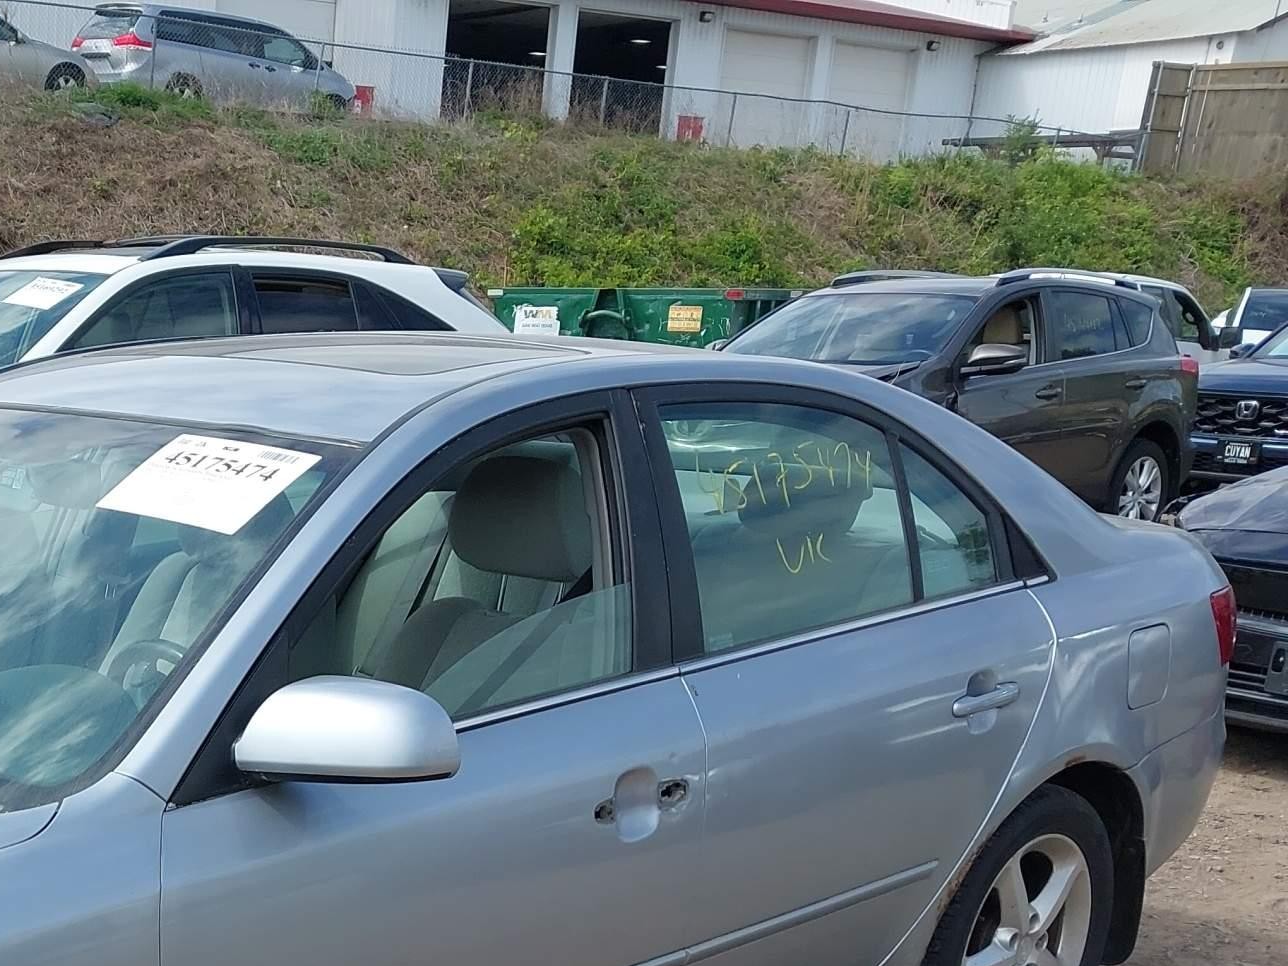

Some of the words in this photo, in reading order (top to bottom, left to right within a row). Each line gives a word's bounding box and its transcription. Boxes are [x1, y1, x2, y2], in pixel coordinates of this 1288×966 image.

[524, 309, 552, 319] WM
[1224, 445, 1252, 458] CUYAN
[164, 450, 281, 482] 45175474
